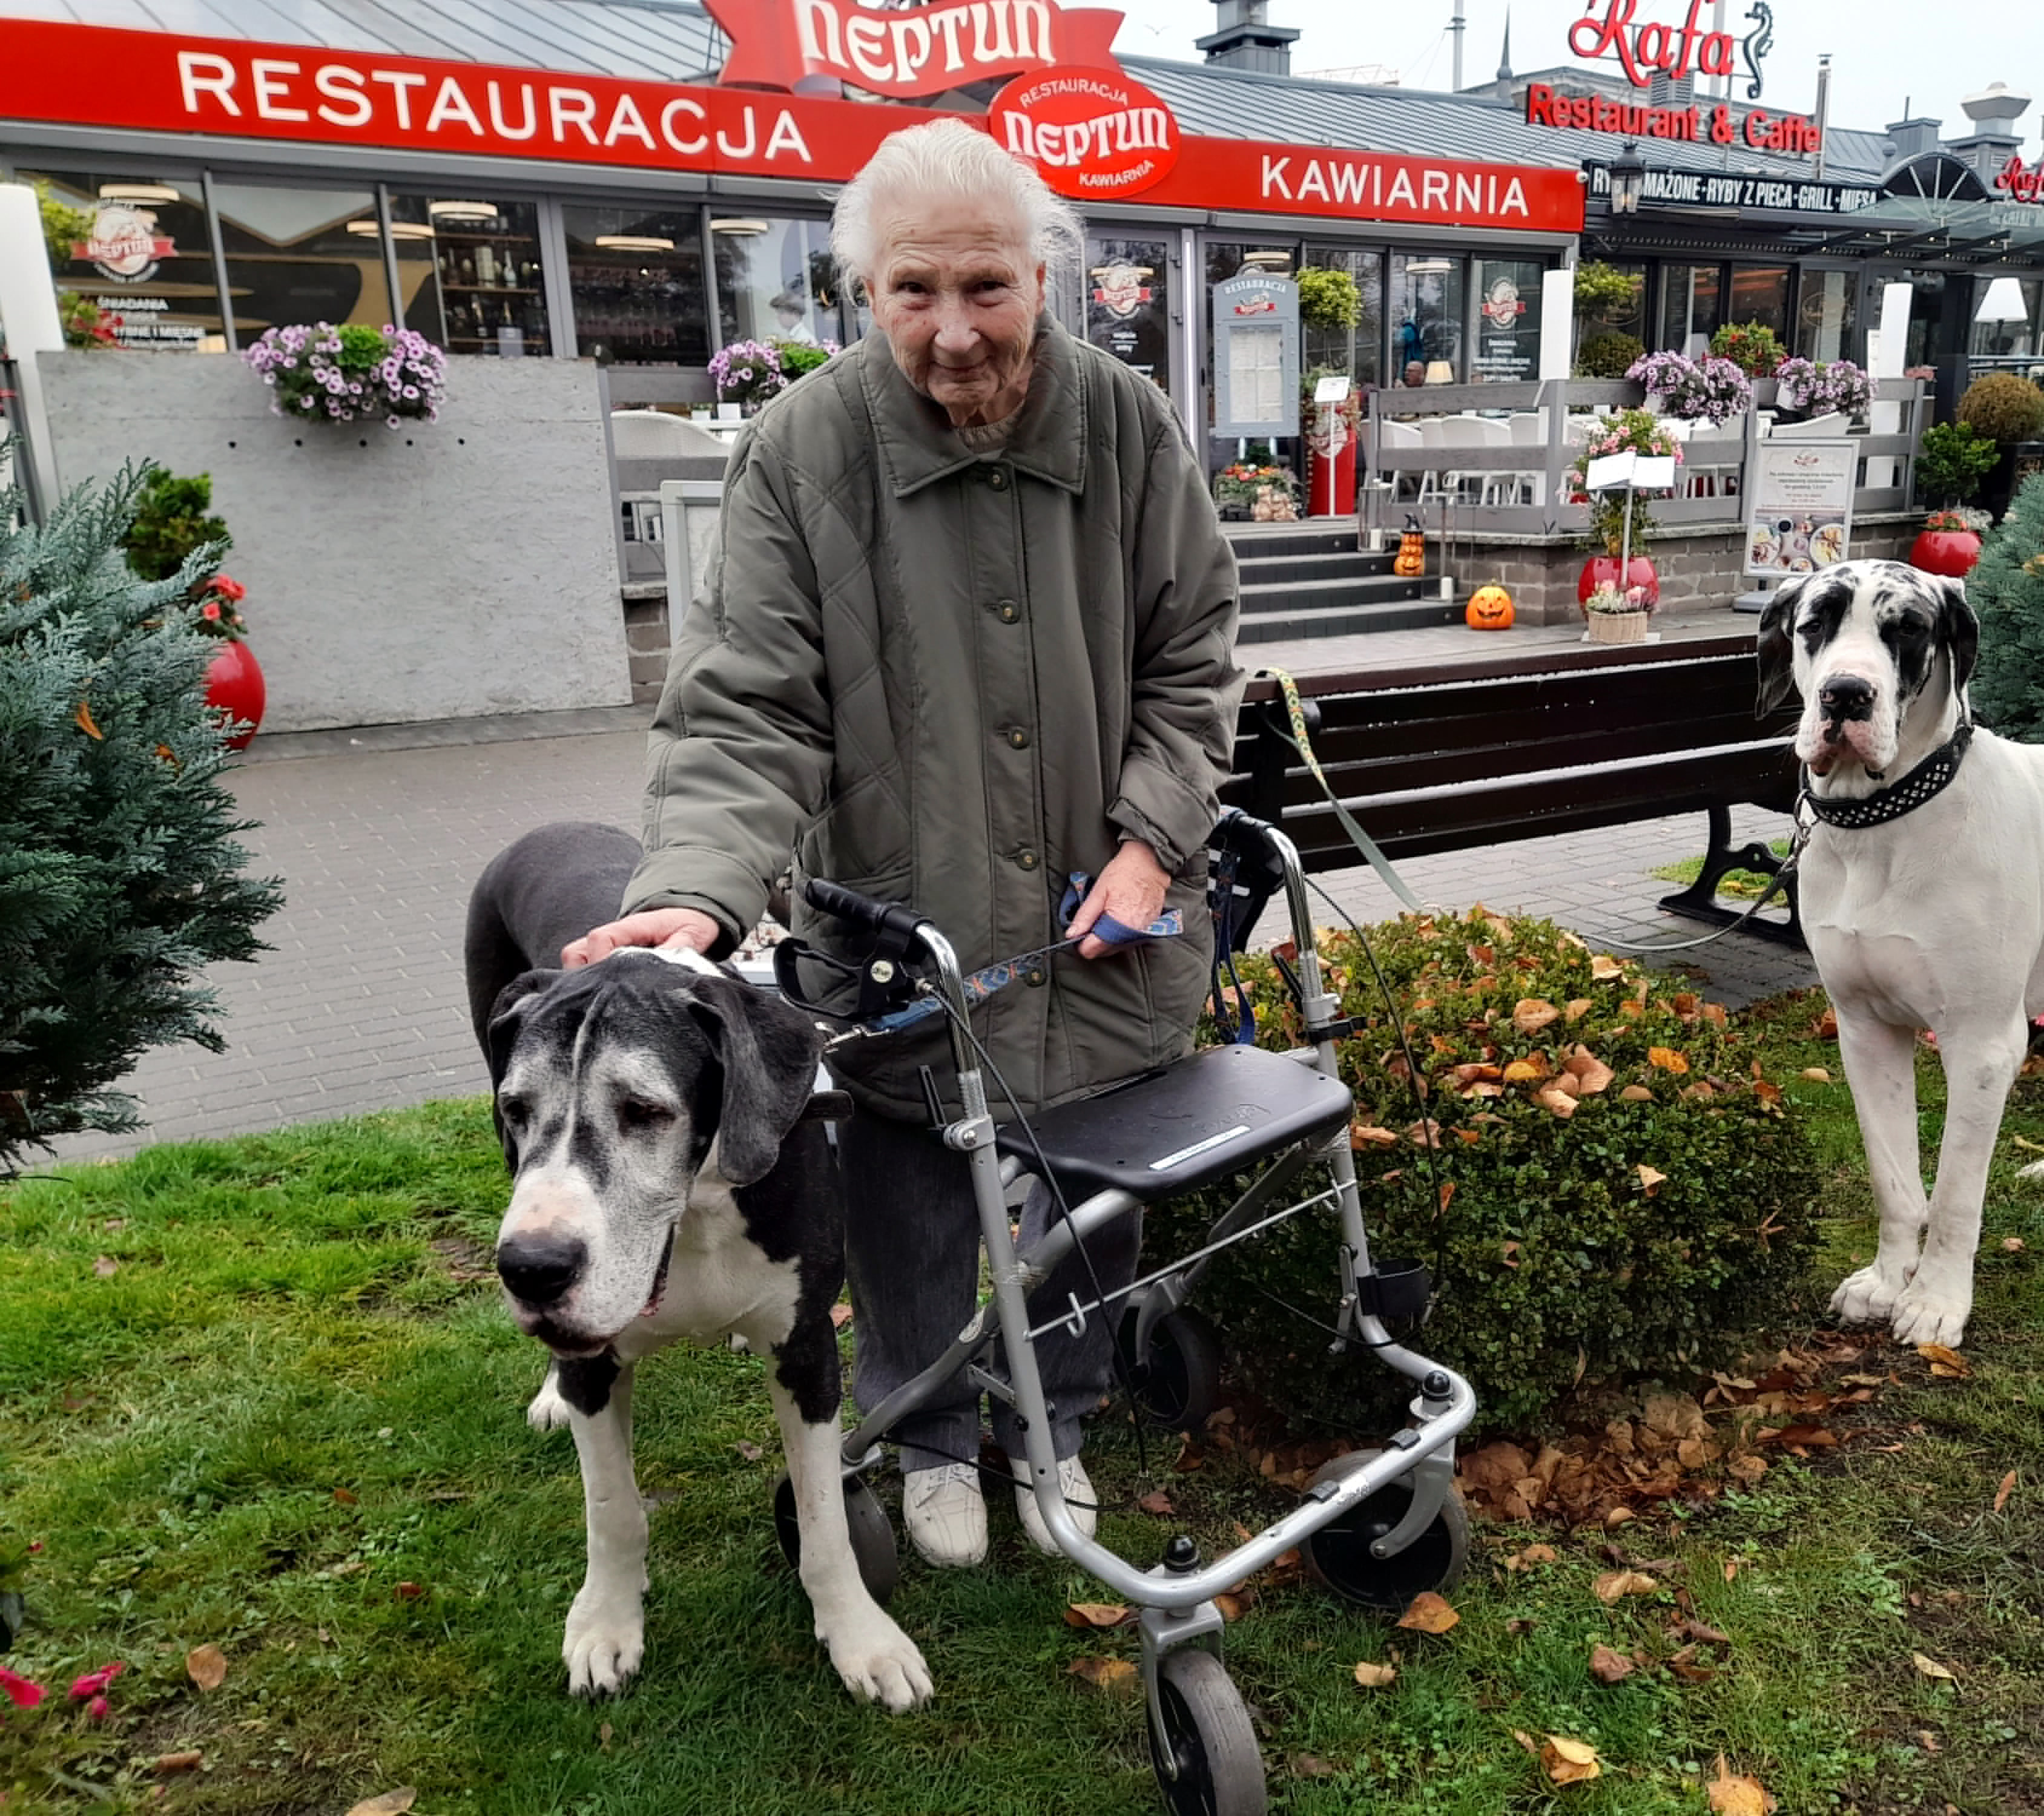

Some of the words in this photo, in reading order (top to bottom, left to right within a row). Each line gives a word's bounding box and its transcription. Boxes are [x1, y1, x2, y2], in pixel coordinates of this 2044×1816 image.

[795, 0, 1056, 82] NEPTUN
[177, 52, 813, 163] RESTAURACJA
[1020, 77, 1129, 108] RESTAURACJA
[1526, 83, 1699, 140] Restaurant
[1710, 104, 1734, 143] &
[1744, 110, 1821, 153] Caffe
[1002, 107, 1171, 167] NEPTUN
[1079, 160, 1155, 186] KAWIARNIA
[1261, 154, 1529, 217] KAWIARNIA
[1637, 169, 1701, 201] MAŻONE
[1706, 177, 1744, 204] RYBY
[1744, 180, 1755, 205] Z
[1756, 182, 1793, 208] PIECA
[1798, 185, 1834, 211] GRILL
